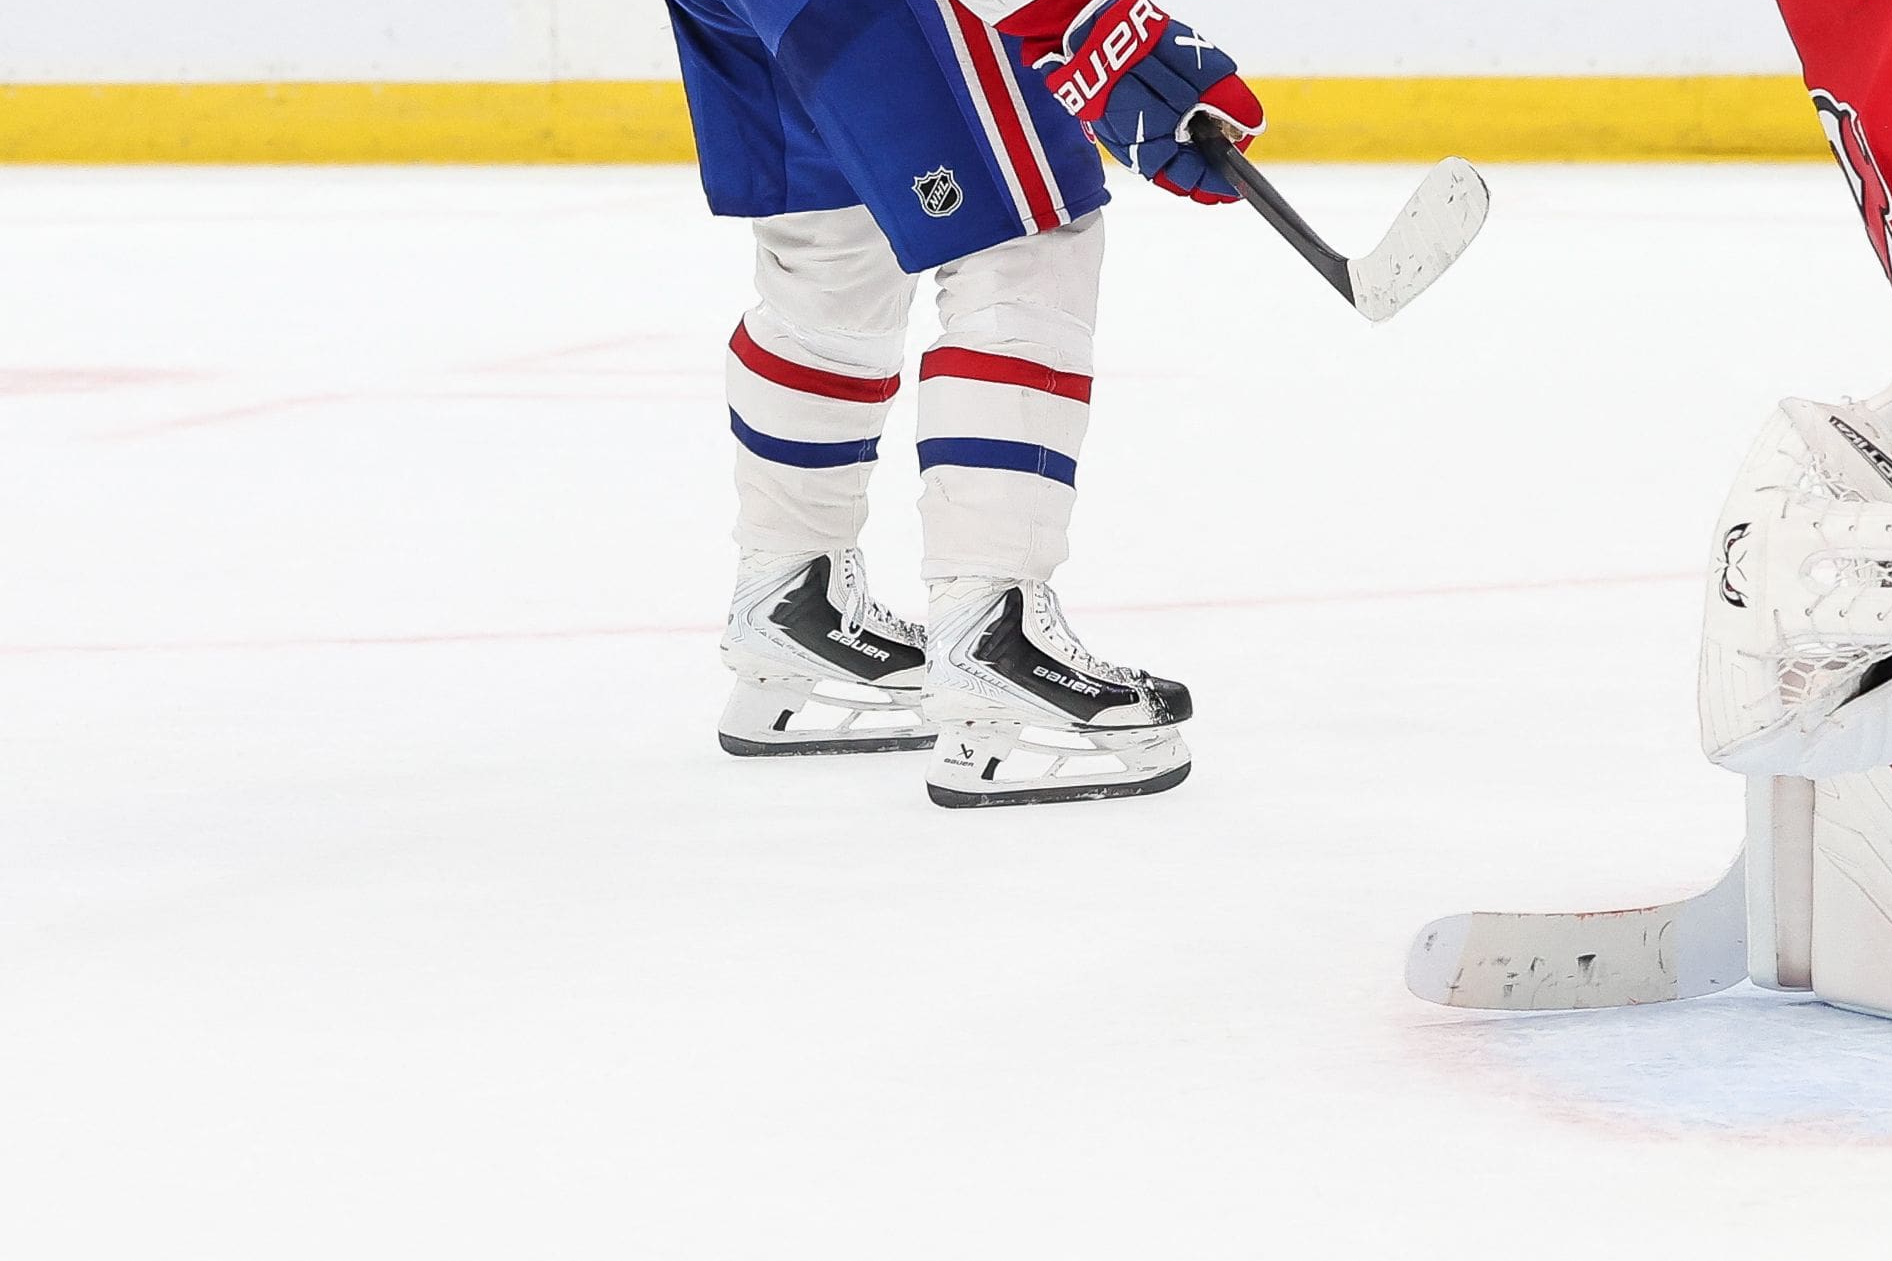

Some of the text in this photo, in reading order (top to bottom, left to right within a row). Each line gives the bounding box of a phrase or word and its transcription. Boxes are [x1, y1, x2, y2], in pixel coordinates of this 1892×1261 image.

[929, 180, 949, 210] NHL
[826, 628, 891, 663] BAUER
[1031, 664, 1102, 699] BAUER
[943, 757, 975, 768] BAUER
